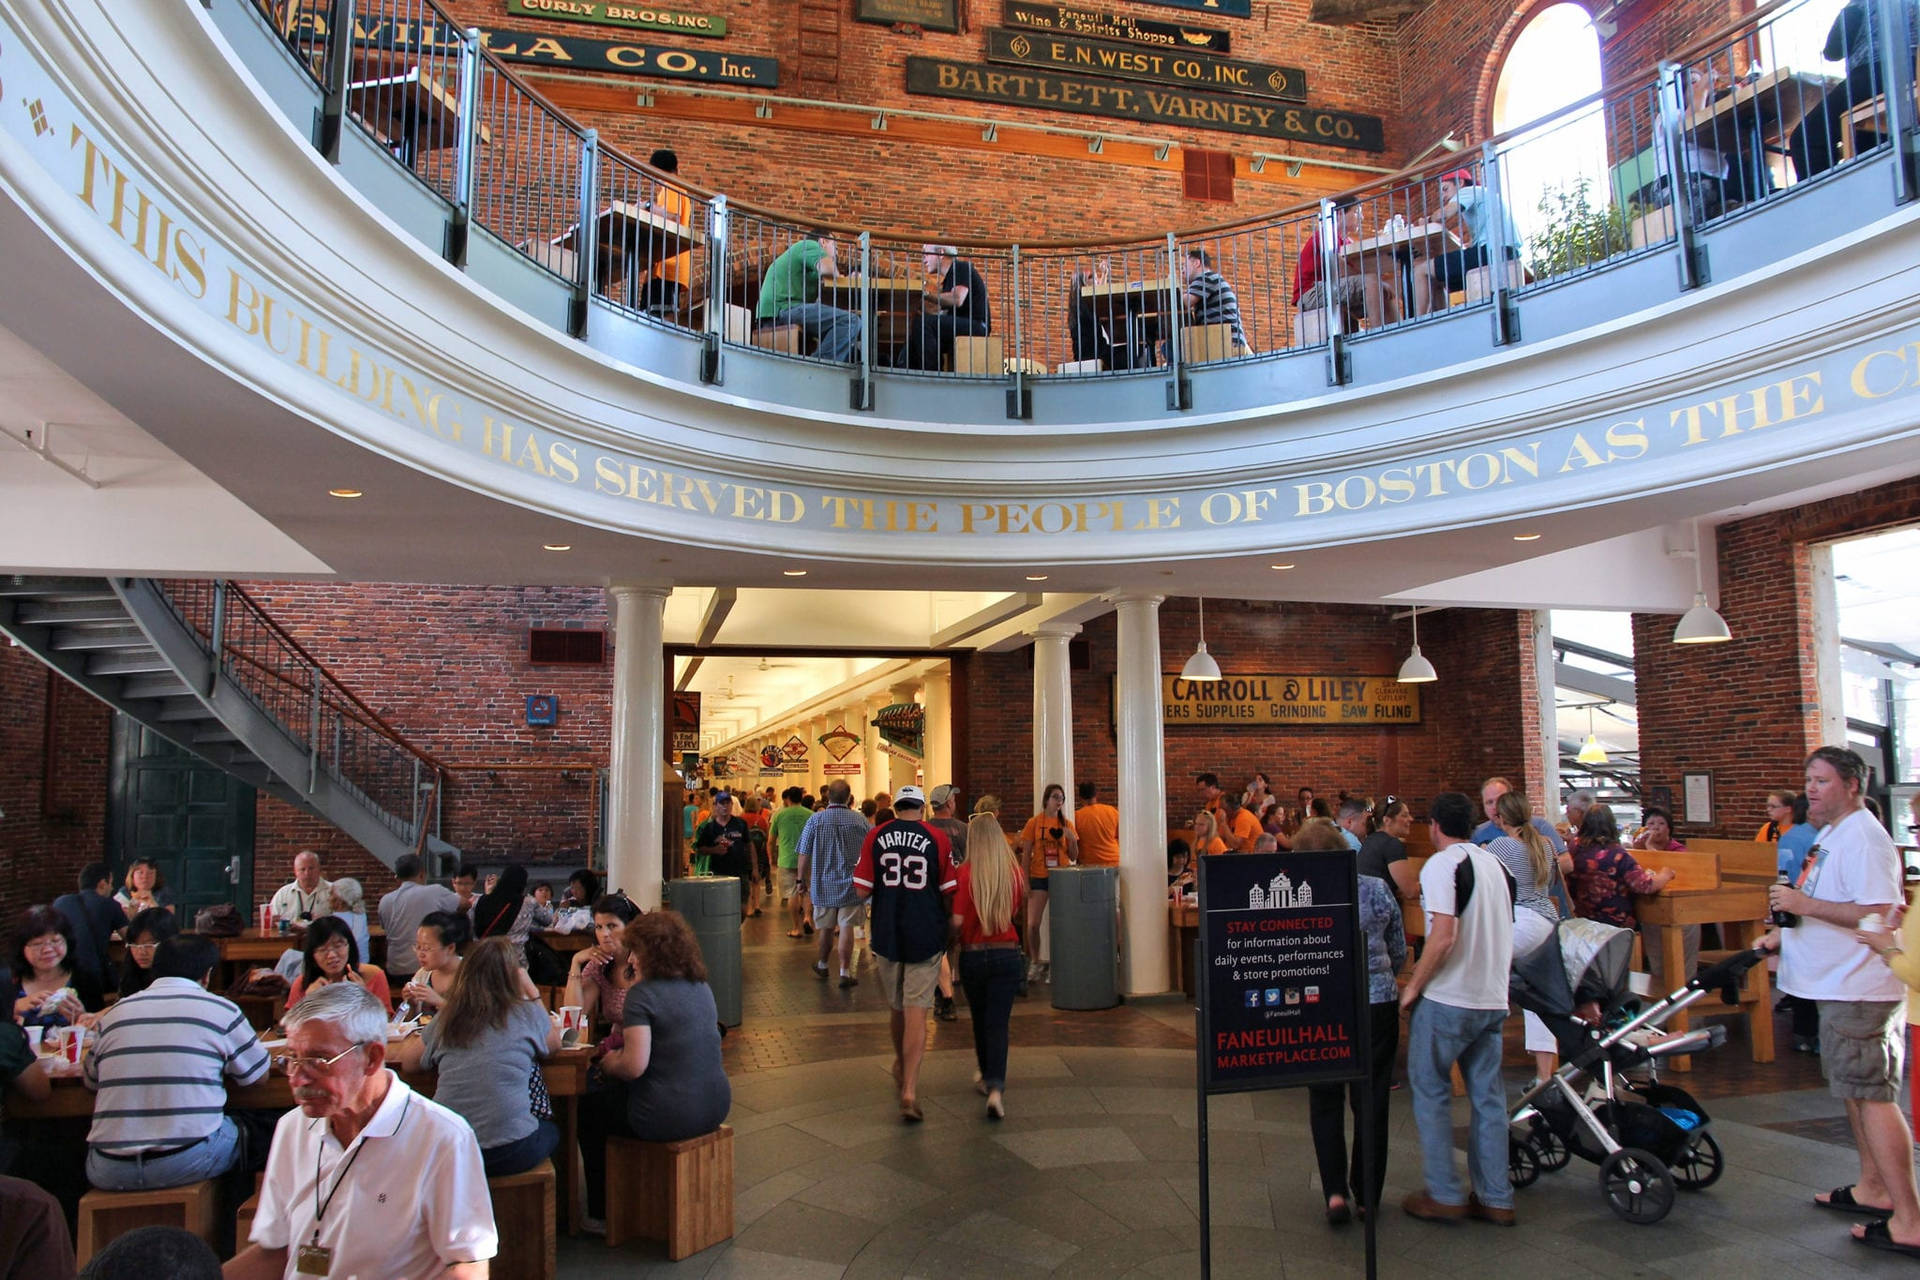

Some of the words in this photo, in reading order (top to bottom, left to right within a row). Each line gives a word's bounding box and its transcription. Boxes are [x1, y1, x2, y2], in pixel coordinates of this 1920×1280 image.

[523, 0, 597, 16] CURLY
[1016, 11, 1051, 27] Wine
[1058, 18, 1069, 29] &
[1075, 19, 1121, 37] Spirits
[1127, 27, 1176, 45] Shoppe
[1112, 16, 1136, 28] Hall
[606, 46, 708, 74] CO.
[720, 57, 756, 79] Inc.
[937, 64, 1140, 113] BARTLETT,
[1145, 90, 1276, 128] VARNEY
[1284, 110, 1308, 134] &
[1315, 114, 1361, 141] CO.
[70, 122, 207, 299] THIS
[225, 266, 463, 441] BUILDING
[481, 415, 579, 484] HAS
[595, 456, 806, 524] SERVED
[822, 496, 938, 533] THE
[957, 497, 1182, 534] PEOPLE
[1200, 488, 1278, 525] OF
[1293, 441, 1542, 517] BOSTON
[1559, 417, 1649, 473] AS
[1670, 371, 1824, 448] THE
[1172, 678, 1273, 701] CARROLL
[1282, 679, 1300, 701] &
[1308, 678, 1367, 701] LILEY
[1196, 703, 1255, 718] SUPPLIES
[1270, 703, 1327, 718] GRINDING
[1341, 703, 1368, 718] SAW
[1374, 703, 1412, 718] FILING
[877, 831, 931, 854] VARITEK
[880, 852, 928, 890] 33
[1226, 920, 1256, 934] STAY
[1260, 917, 1335, 932] CONNECTED
[1227, 938, 1241, 950] for
[1244, 935, 1301, 948] information
[1303, 934, 1331, 945] about
[1214, 955, 1238, 968] daily
[1240, 953, 1276, 965] events,
[1278, 949, 1345, 965] performances
[1232, 970, 1242, 981] &
[1243, 969, 1269, 980] store
[1271, 964, 1330, 981] promotions!
[1217, 1046, 1351, 1069] MARKETPLACE.COM
